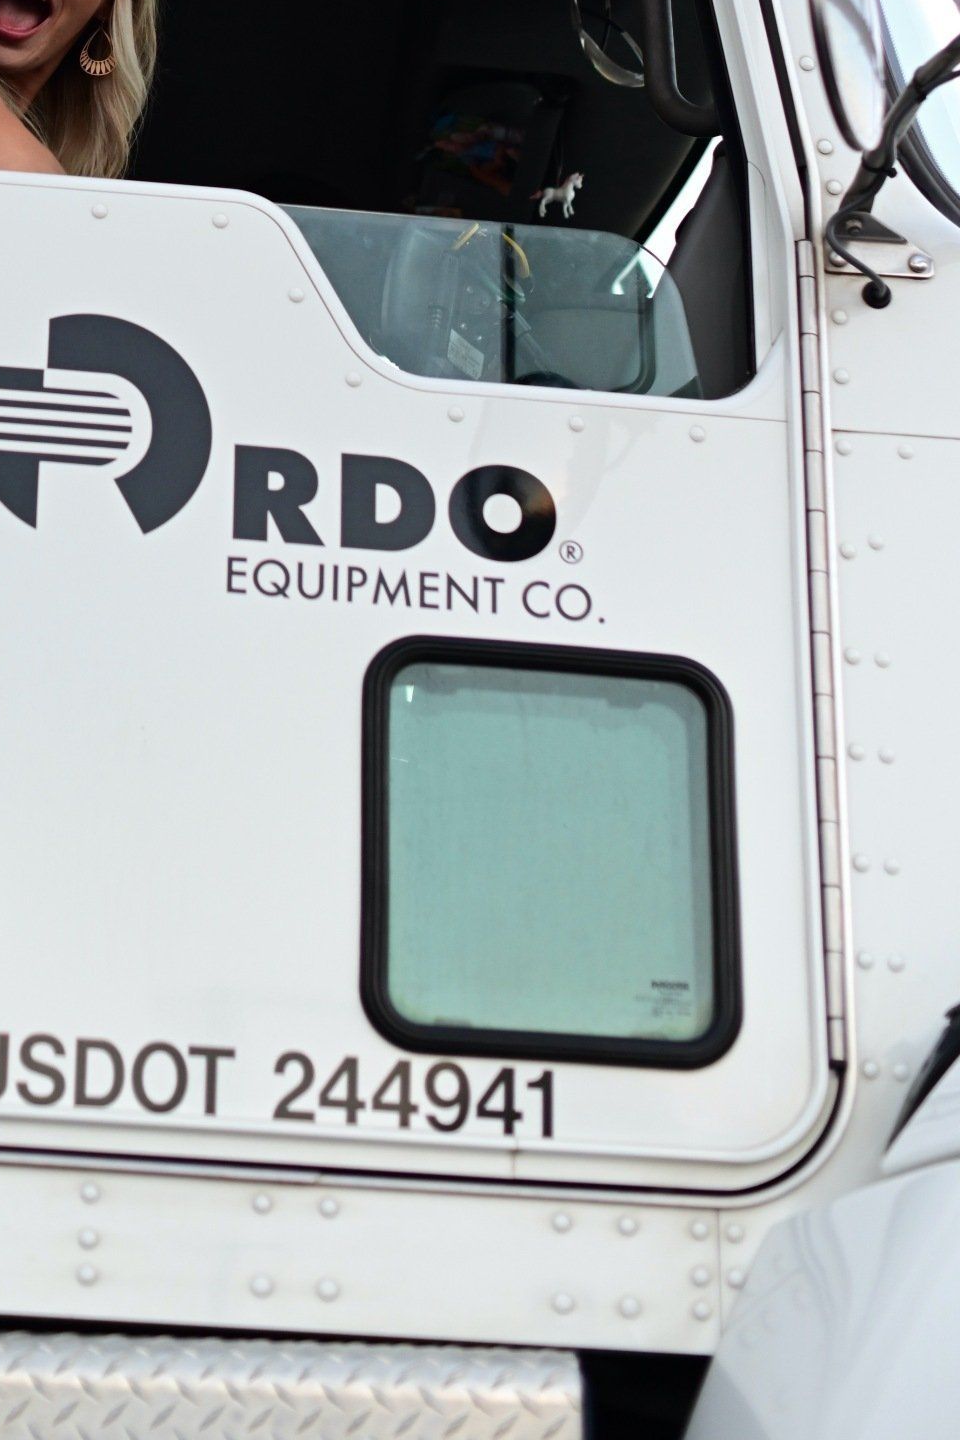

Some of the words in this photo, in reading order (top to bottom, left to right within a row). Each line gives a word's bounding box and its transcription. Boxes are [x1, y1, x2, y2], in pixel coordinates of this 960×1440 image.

[225, 556, 506, 615] EQUIPMENT
[522, 580, 606, 625] CO.
[272, 1050, 555, 1139] 244941
